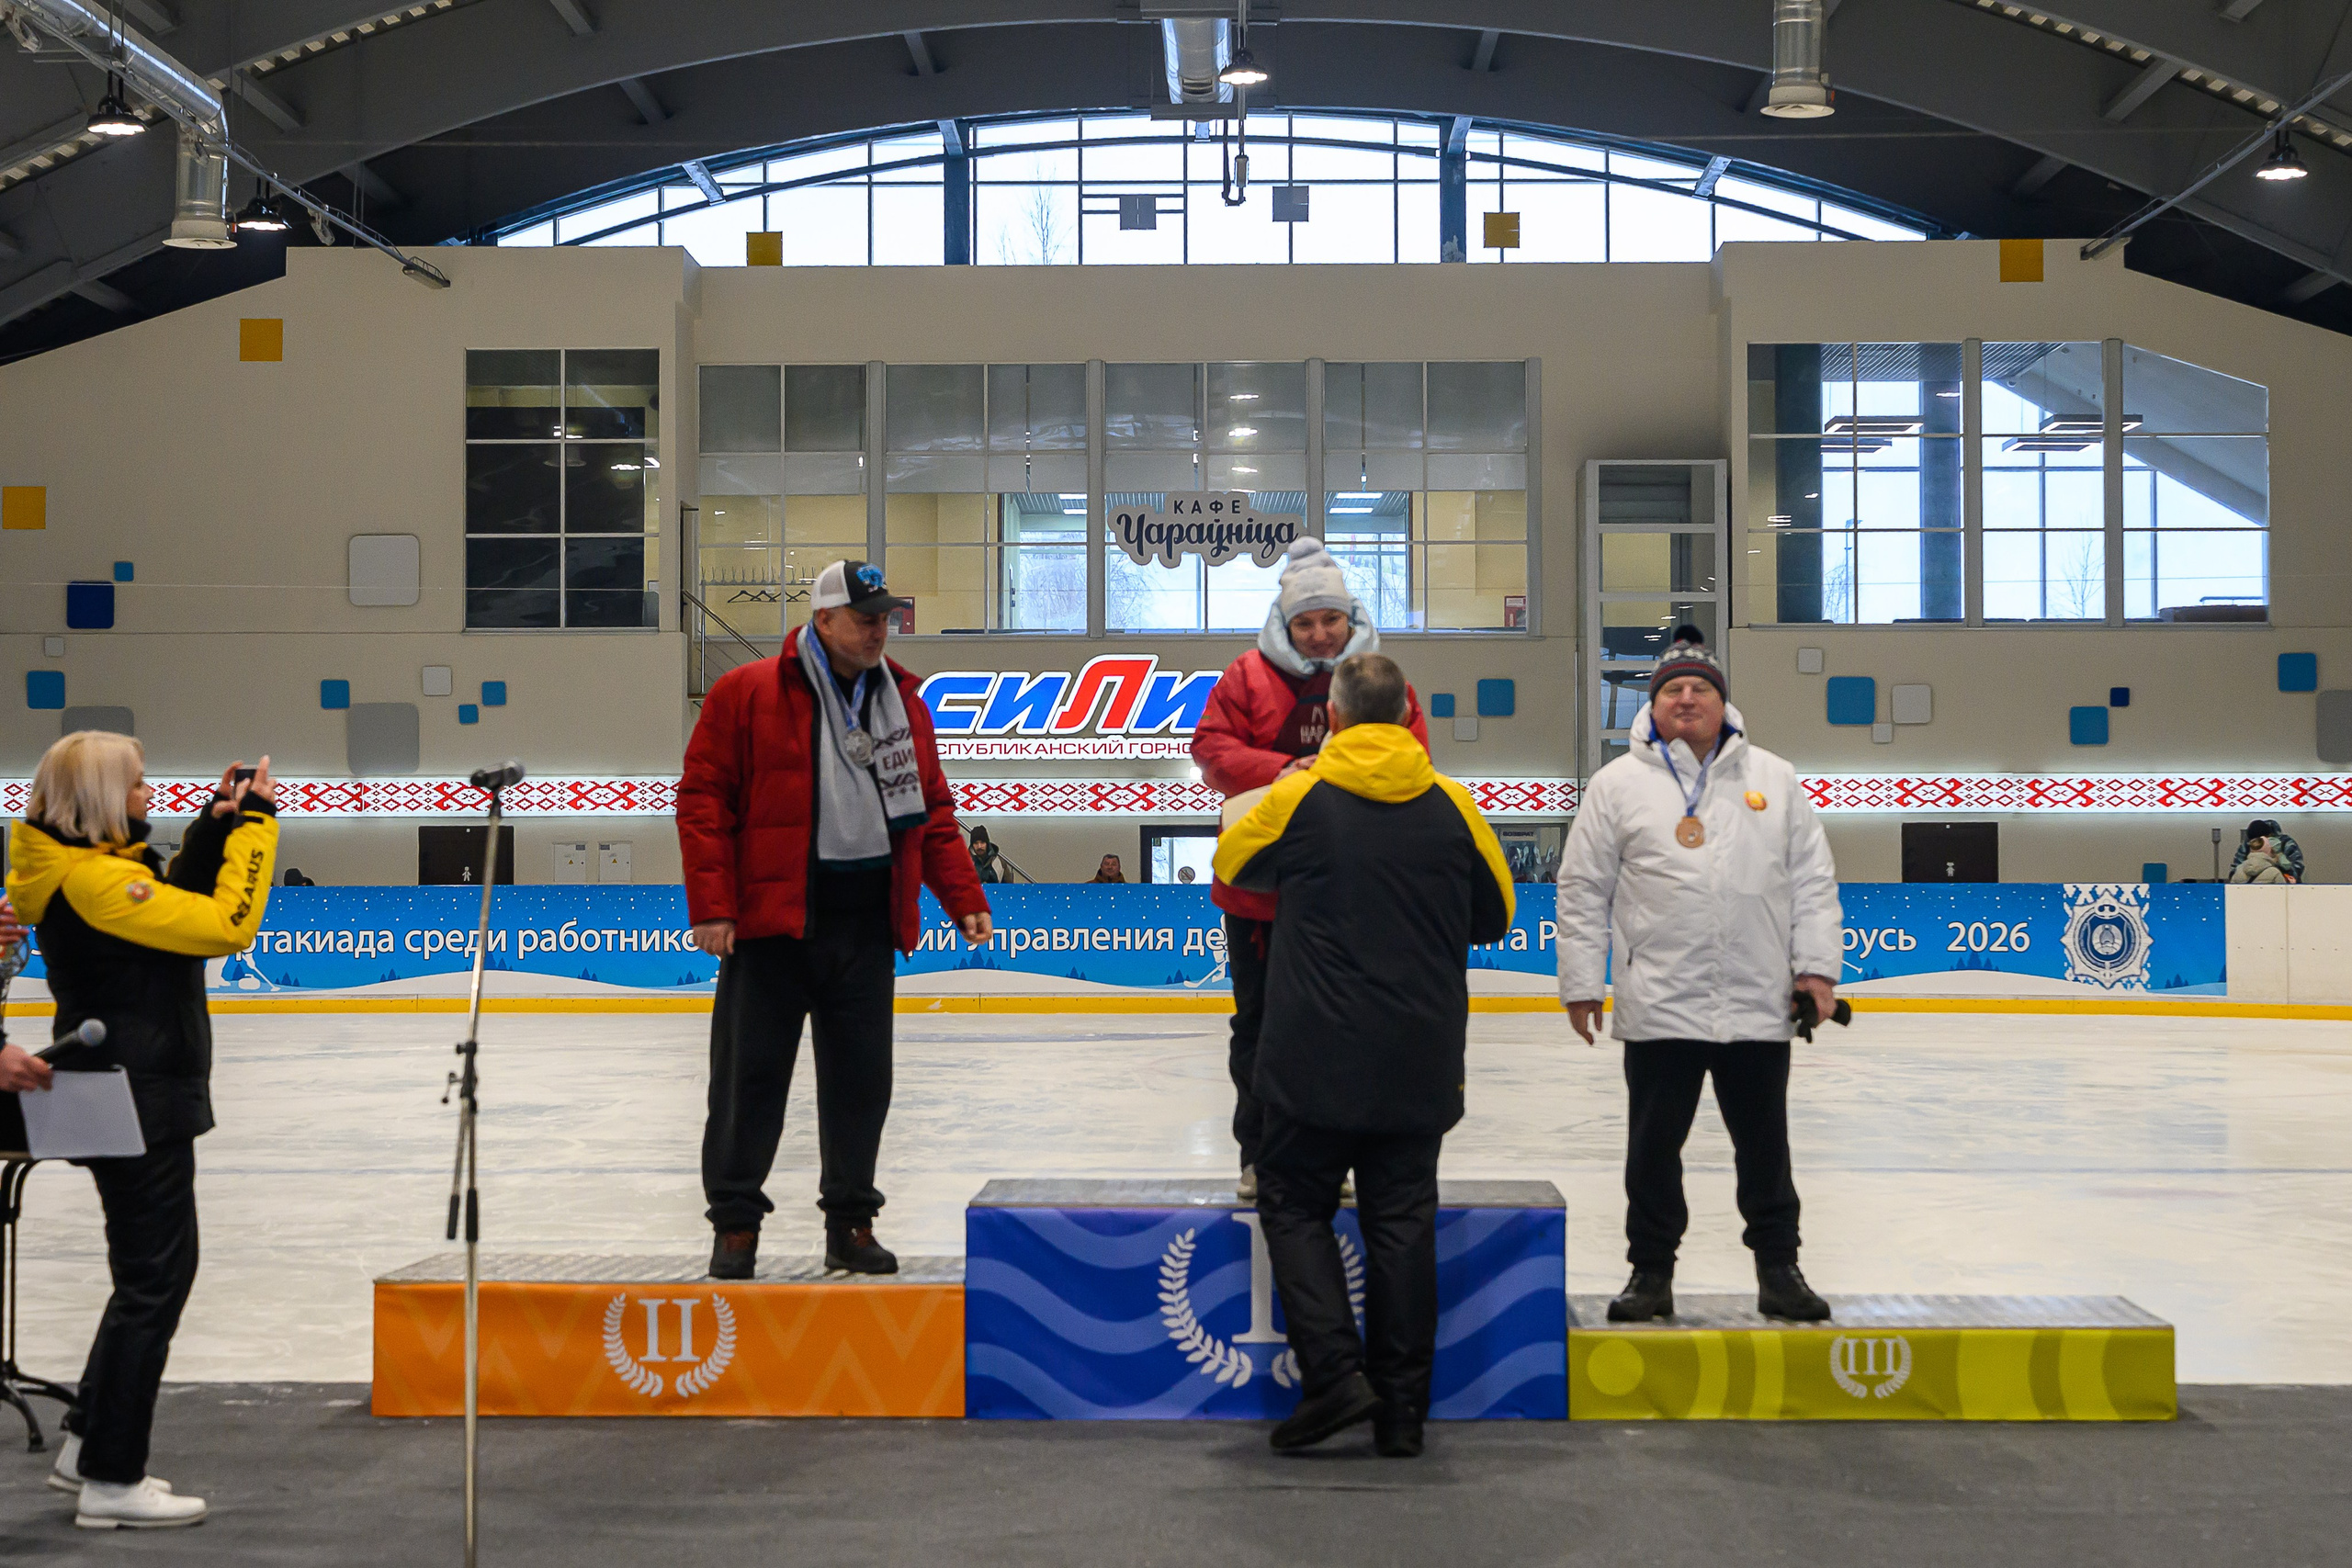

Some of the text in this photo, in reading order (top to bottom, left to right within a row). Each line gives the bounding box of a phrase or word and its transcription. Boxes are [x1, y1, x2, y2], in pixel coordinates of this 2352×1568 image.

[1173, 500, 1240, 514] КАФЕ
[1116, 513, 1298, 559] Чараўніца
[404, 930, 506, 960] среди
[967, 928, 1173, 958] правления
[1947, 921, 2030, 953] 2026
[638, 1299, 701, 1361] II
[1844, 1338, 1897, 1375] III
